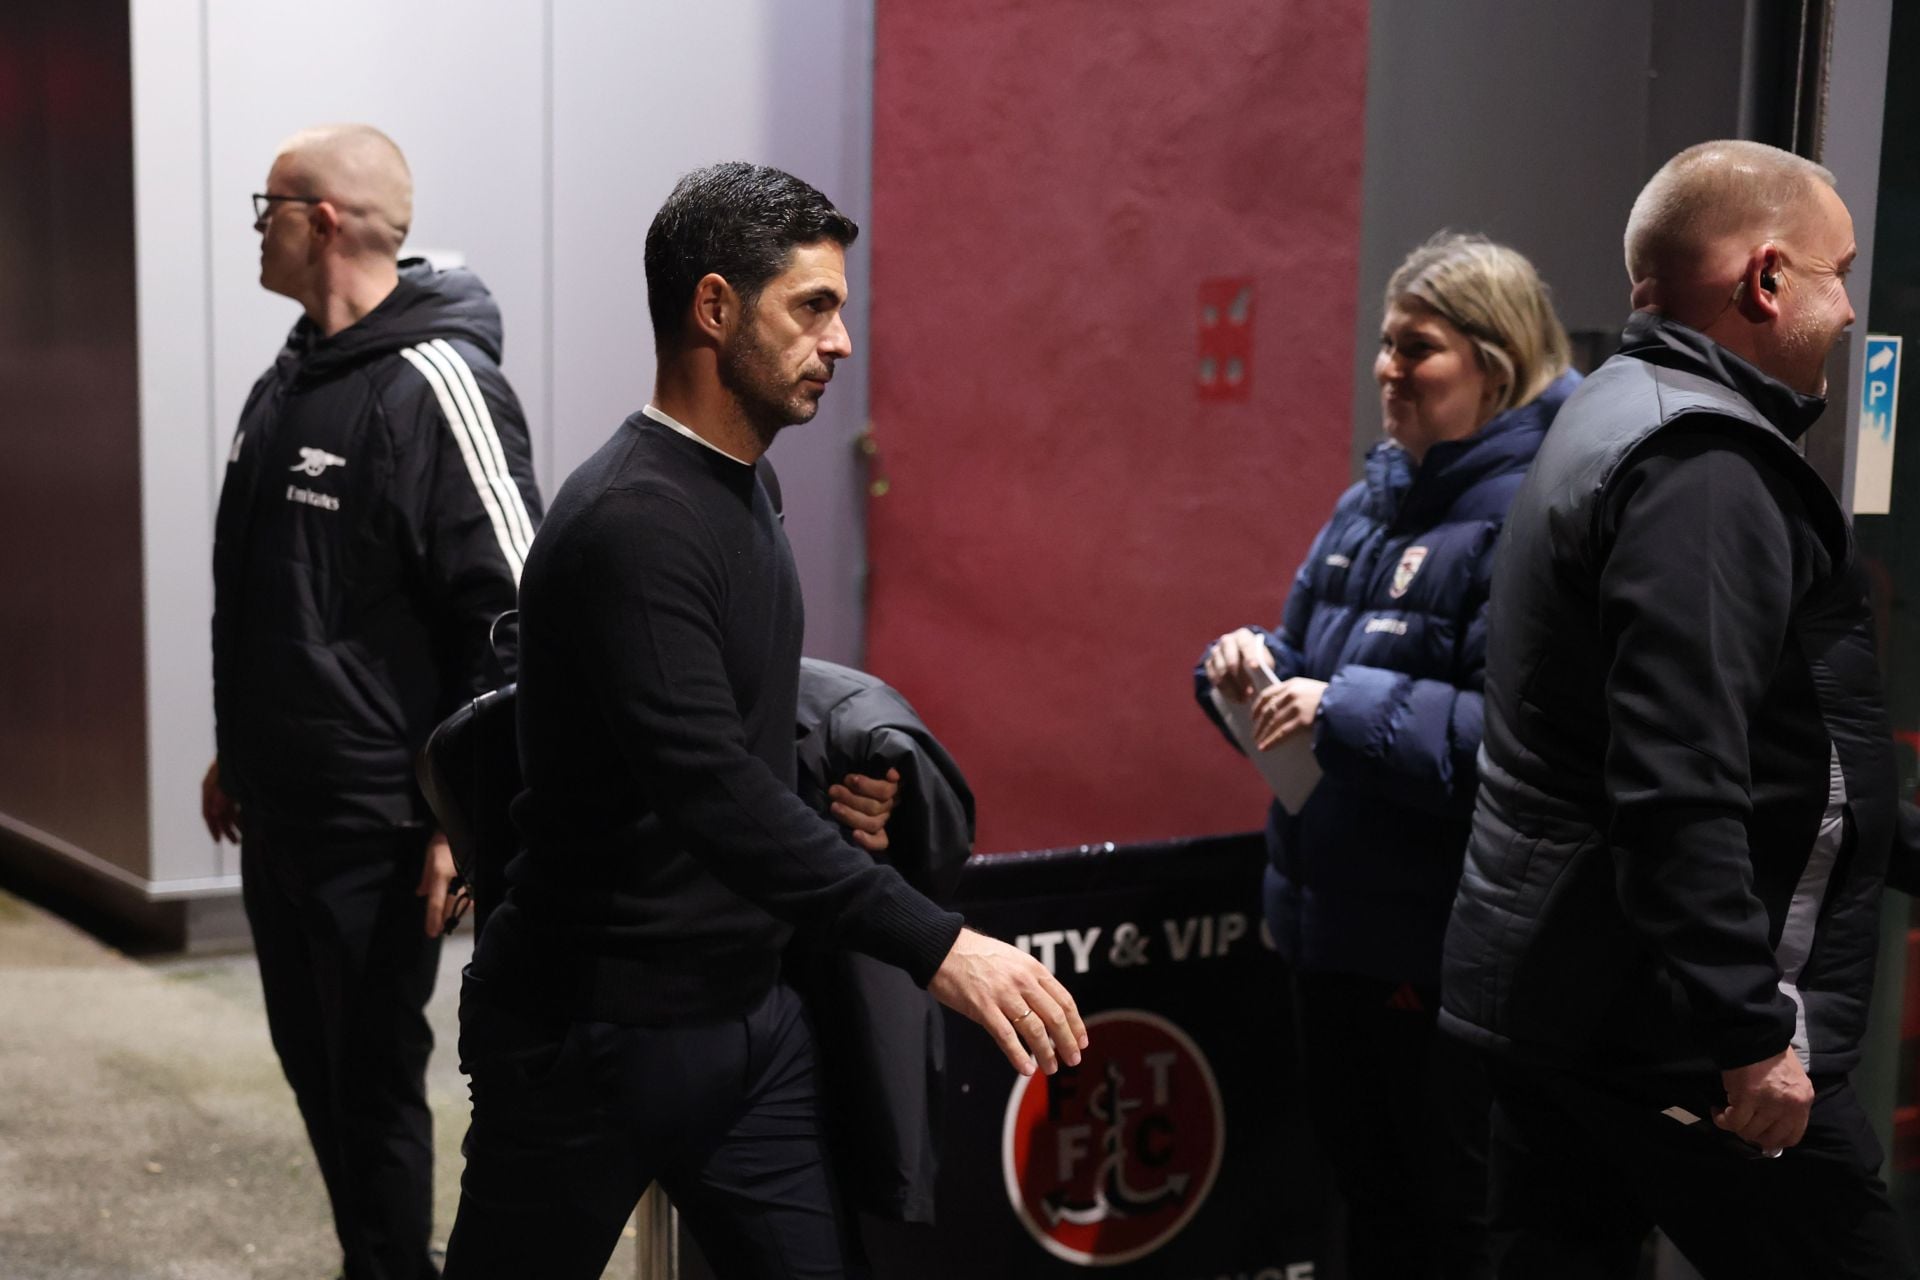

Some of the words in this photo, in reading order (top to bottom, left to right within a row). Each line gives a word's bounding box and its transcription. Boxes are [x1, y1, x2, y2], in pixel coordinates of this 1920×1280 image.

[1107, 921, 1150, 968] &
[1162, 911, 1248, 962] VIP
[1143, 1052, 1178, 1107] T
[1056, 1123, 1092, 1182] F
[1136, 1116, 1175, 1167] C
